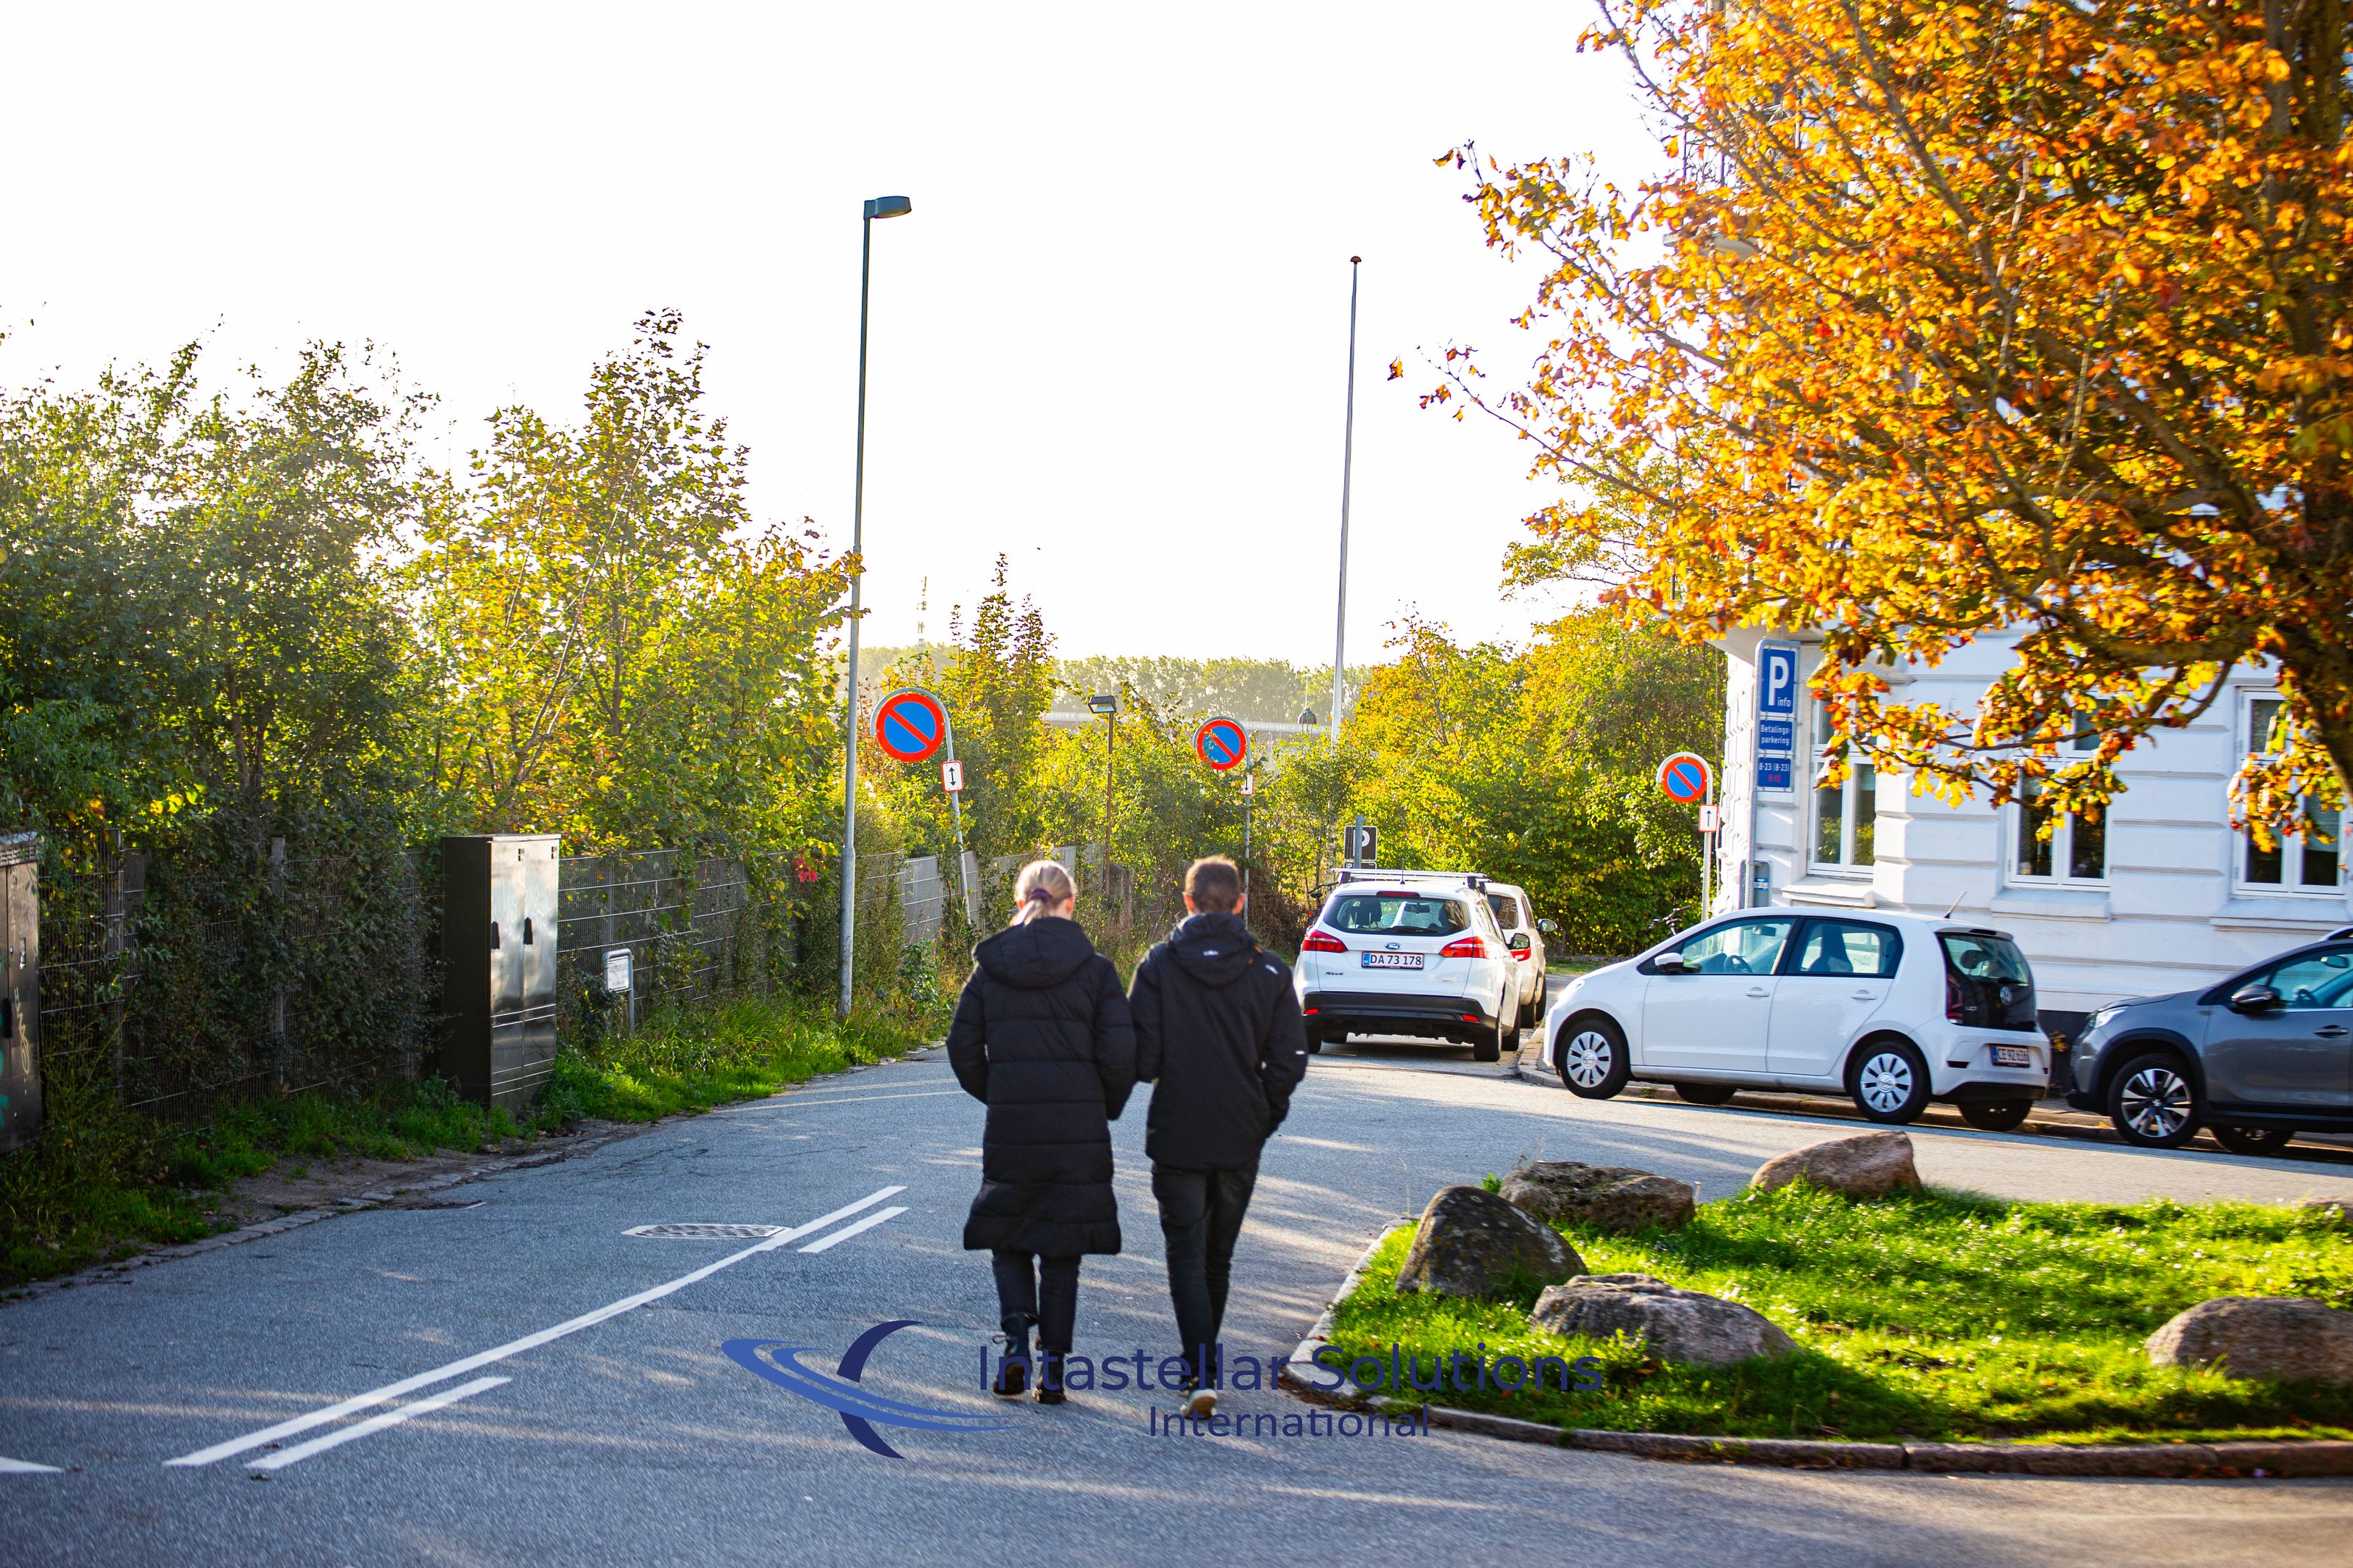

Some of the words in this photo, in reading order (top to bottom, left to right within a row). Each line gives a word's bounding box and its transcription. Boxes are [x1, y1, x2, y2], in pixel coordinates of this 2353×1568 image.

[1768, 656, 1789, 706] P
[1777, 698, 1791, 706] info
[1761, 737, 1790, 746] parkering
[1370, 954, 1385, 964] DA
[1388, 955, 1400, 964] 73
[1403, 956, 1421, 965] 178
